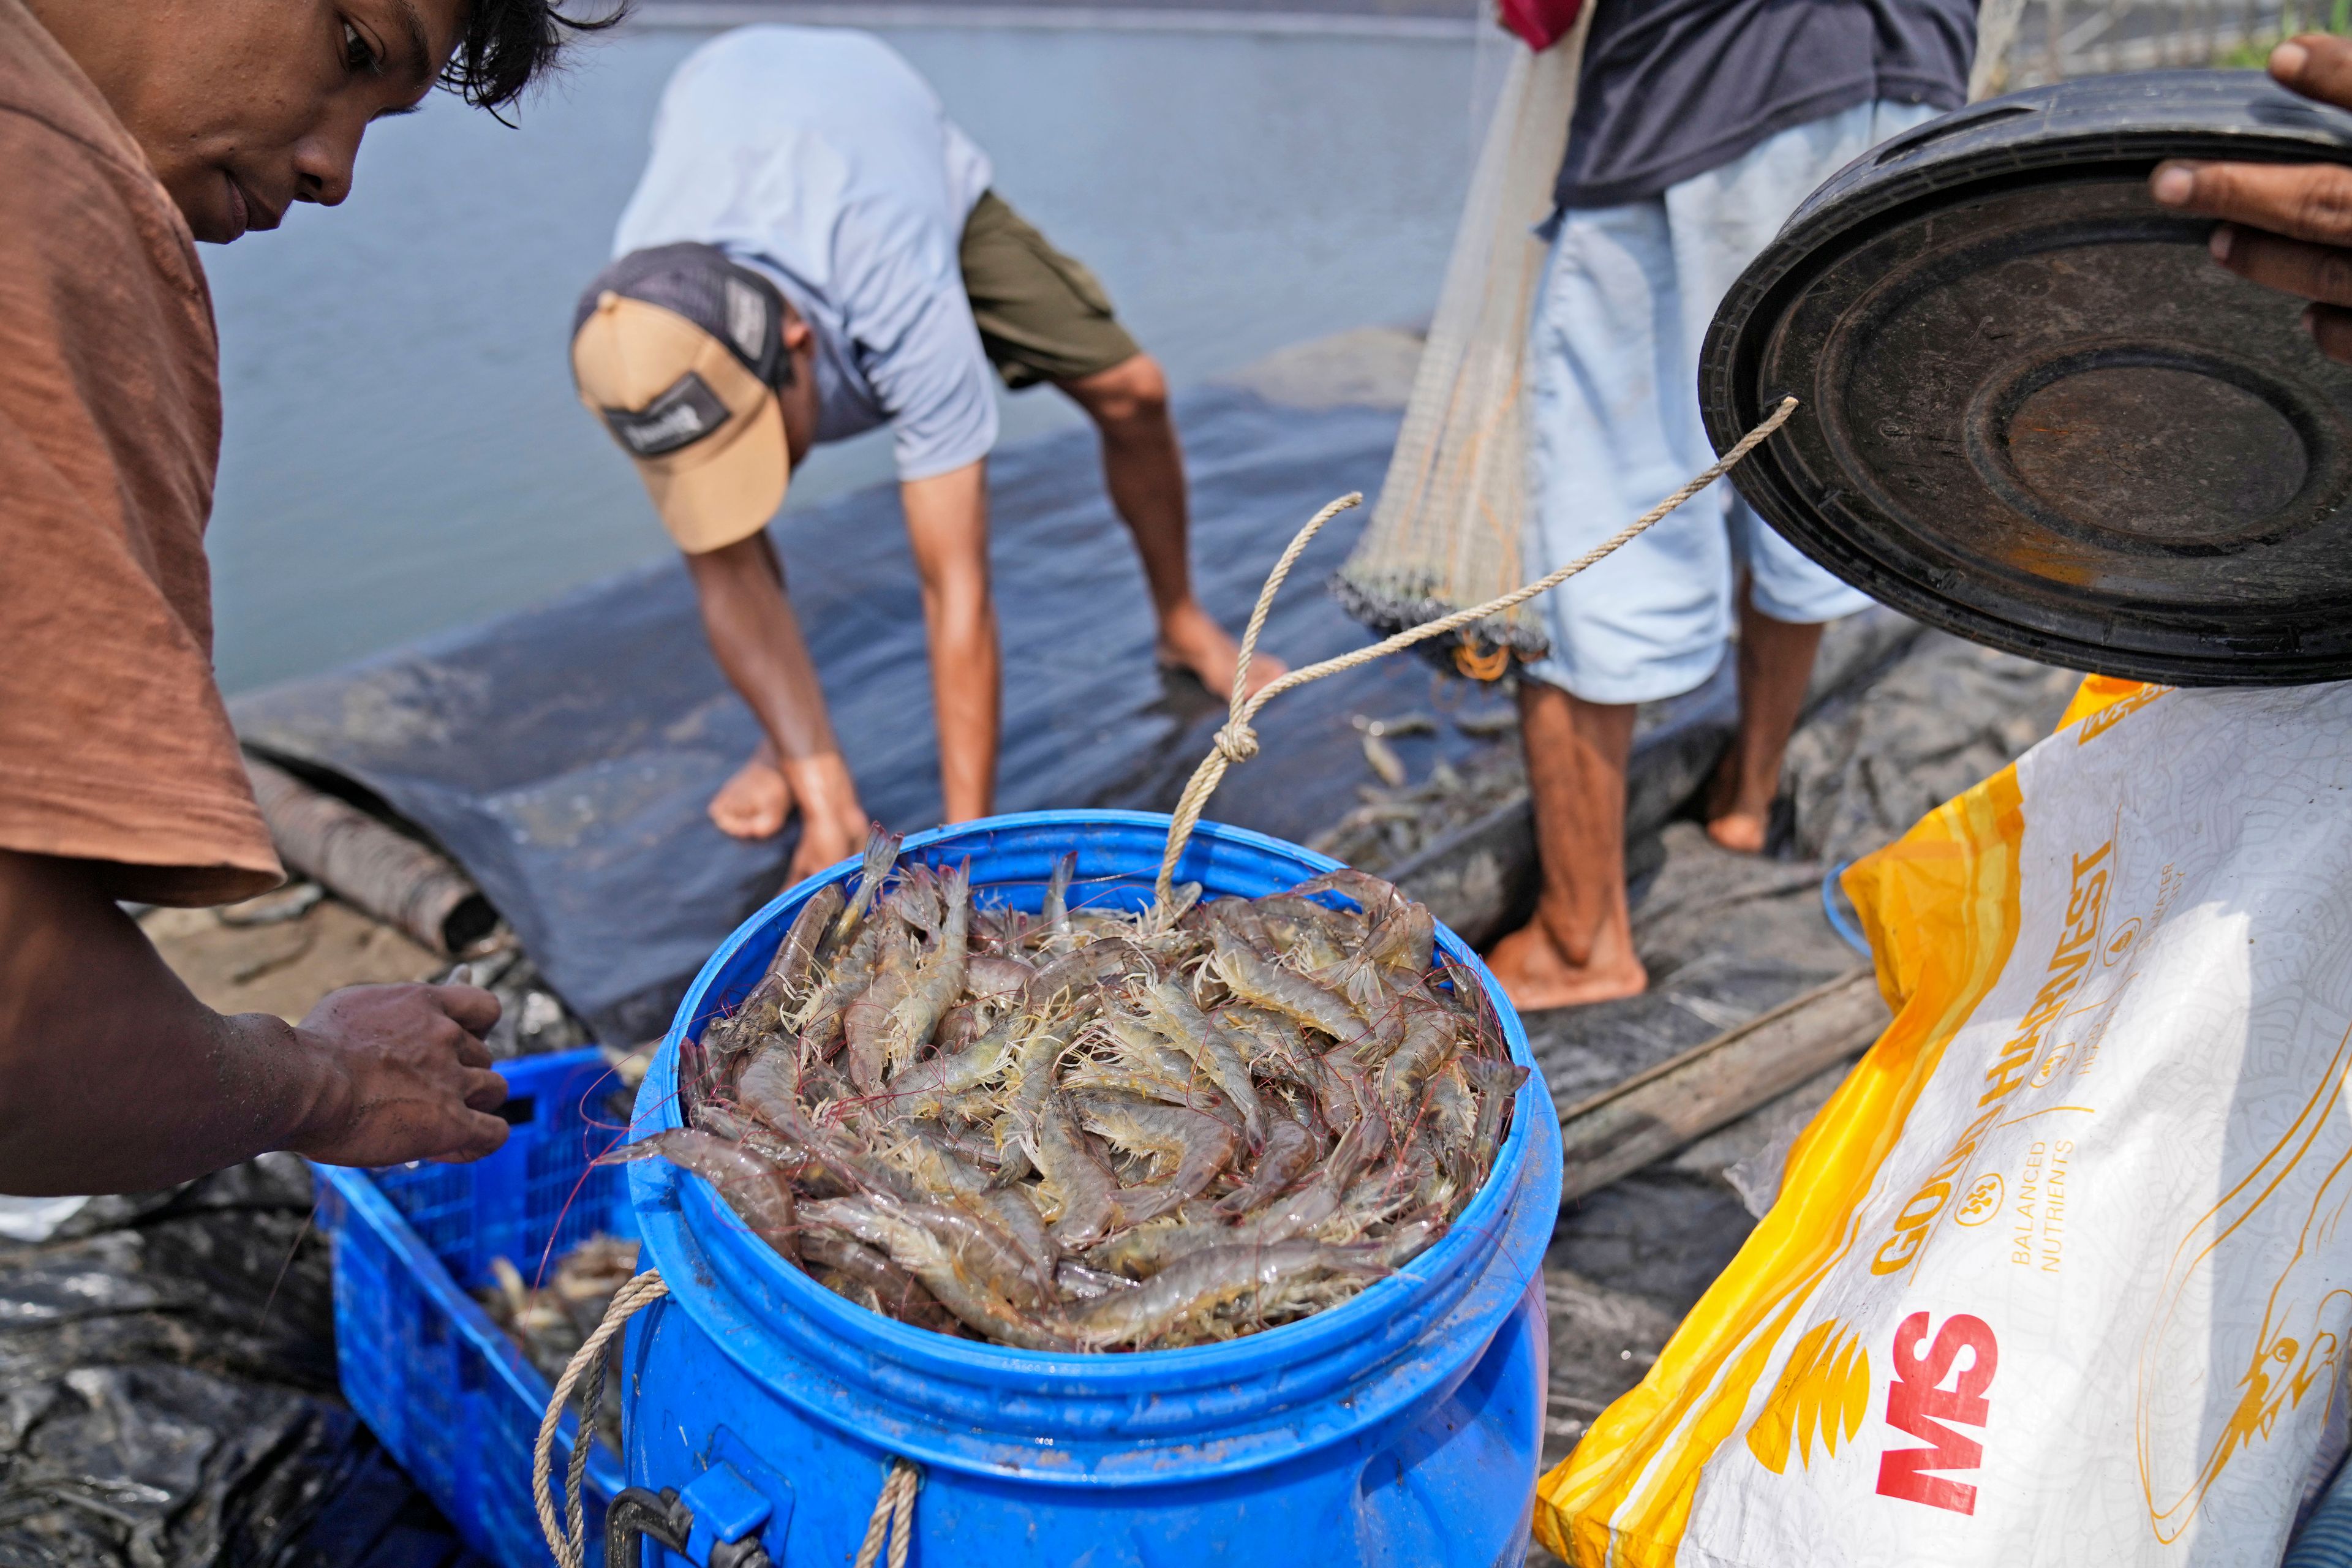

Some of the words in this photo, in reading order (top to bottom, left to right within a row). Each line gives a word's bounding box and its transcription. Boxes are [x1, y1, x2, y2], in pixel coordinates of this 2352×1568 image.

[1870, 1104, 2006, 1276] GOOD
[1977, 840, 2111, 1109] HARVEST
[2011, 1142, 2046, 1265] BALANCED
[2041, 1140, 2075, 1273] NUTRIENTS
[1875, 1311, 1998, 1516] MS
